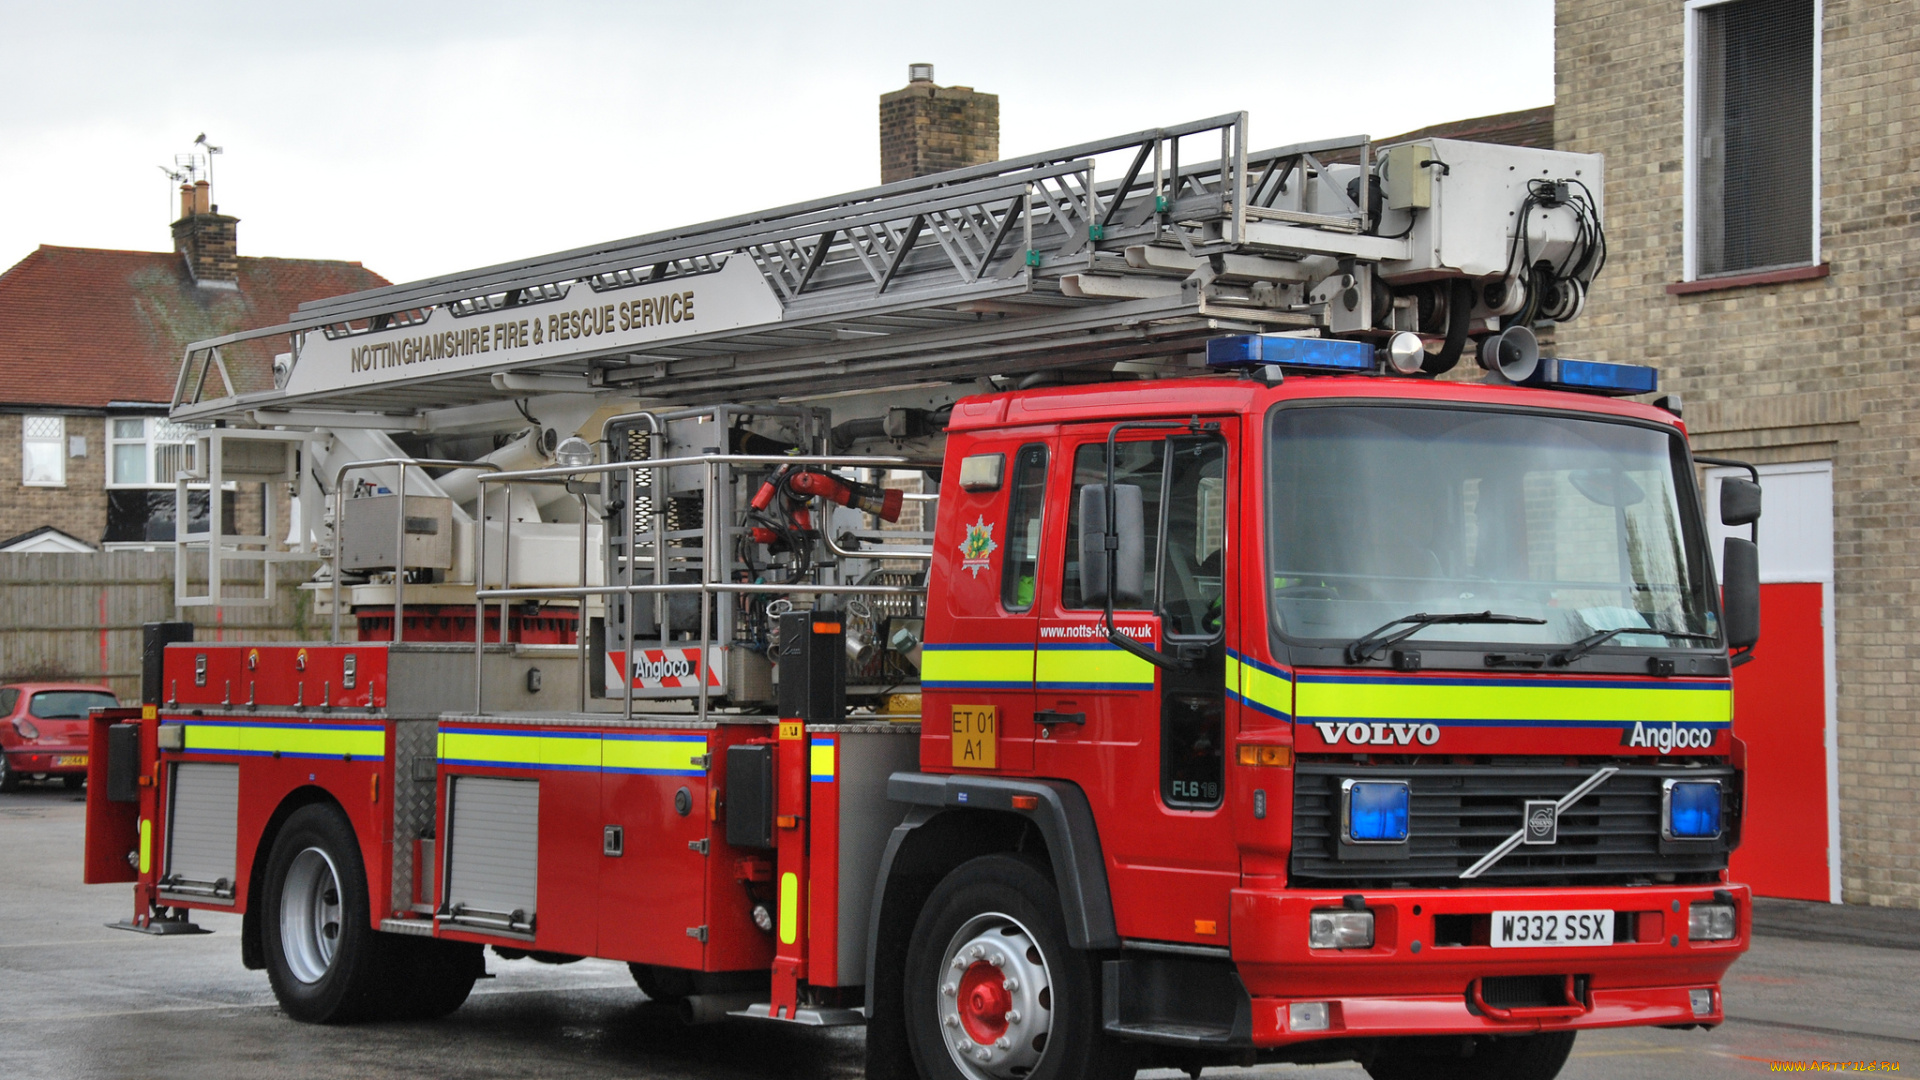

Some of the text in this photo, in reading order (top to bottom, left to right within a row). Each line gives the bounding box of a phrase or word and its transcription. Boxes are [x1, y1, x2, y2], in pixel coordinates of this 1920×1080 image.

[351, 290, 695, 373] NOTTINGHAMSHIRE FIRE & RESCUE SERVICE
[1040, 623, 1152, 638] www.notts-fireov.uk
[634, 655, 690, 684] Angloco
[953, 711, 994, 734] ET 01
[1314, 721, 1441, 746] VOLVO
[963, 739, 982, 761] A1
[1629, 721, 1712, 755] Angloco
[1502, 914, 1605, 942] W332 SSX
